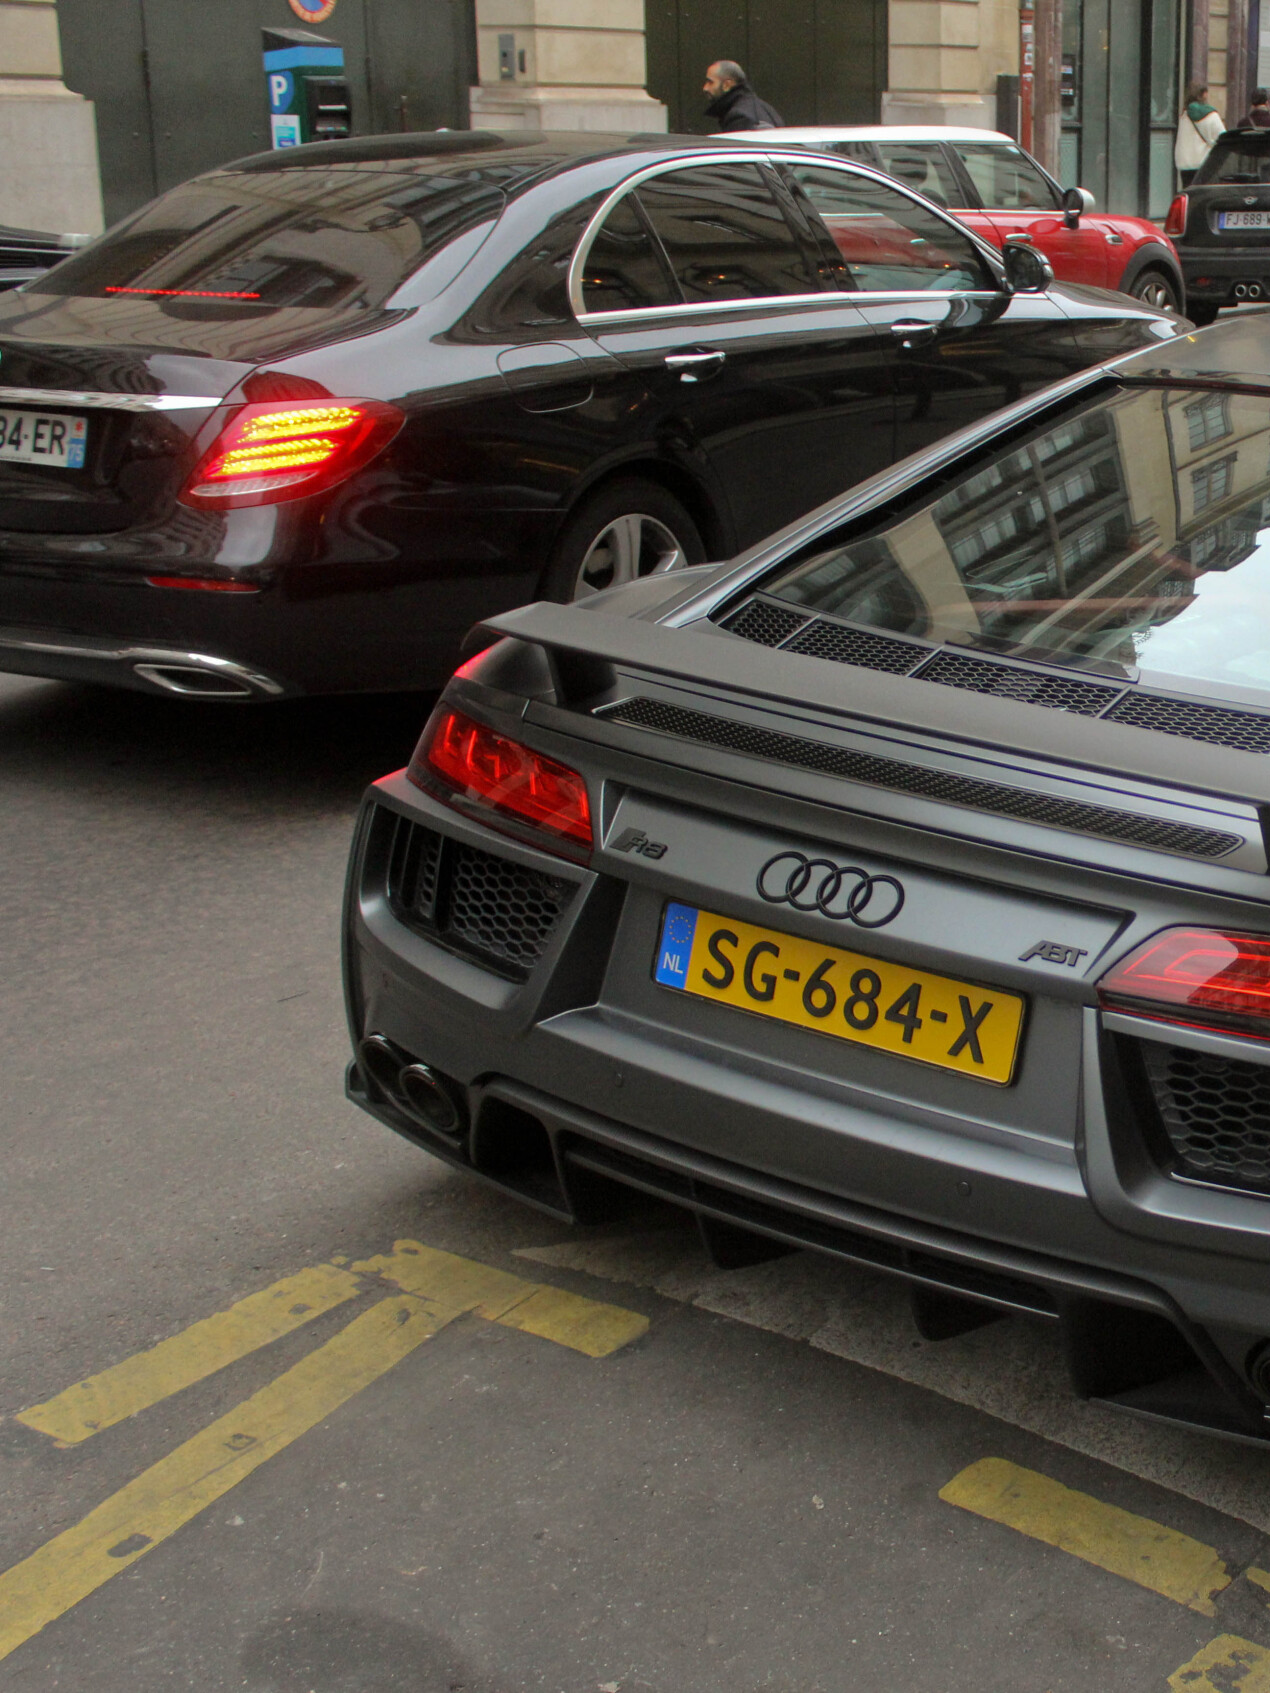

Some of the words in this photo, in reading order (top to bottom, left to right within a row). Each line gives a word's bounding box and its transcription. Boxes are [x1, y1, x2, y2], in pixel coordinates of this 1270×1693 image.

[270, 75, 289, 107] P
[616, 828, 668, 860] R8
[662, 951, 683, 975] NL
[1018, 940, 1089, 967] ABT
[702, 929, 994, 1064] SG-684-X
